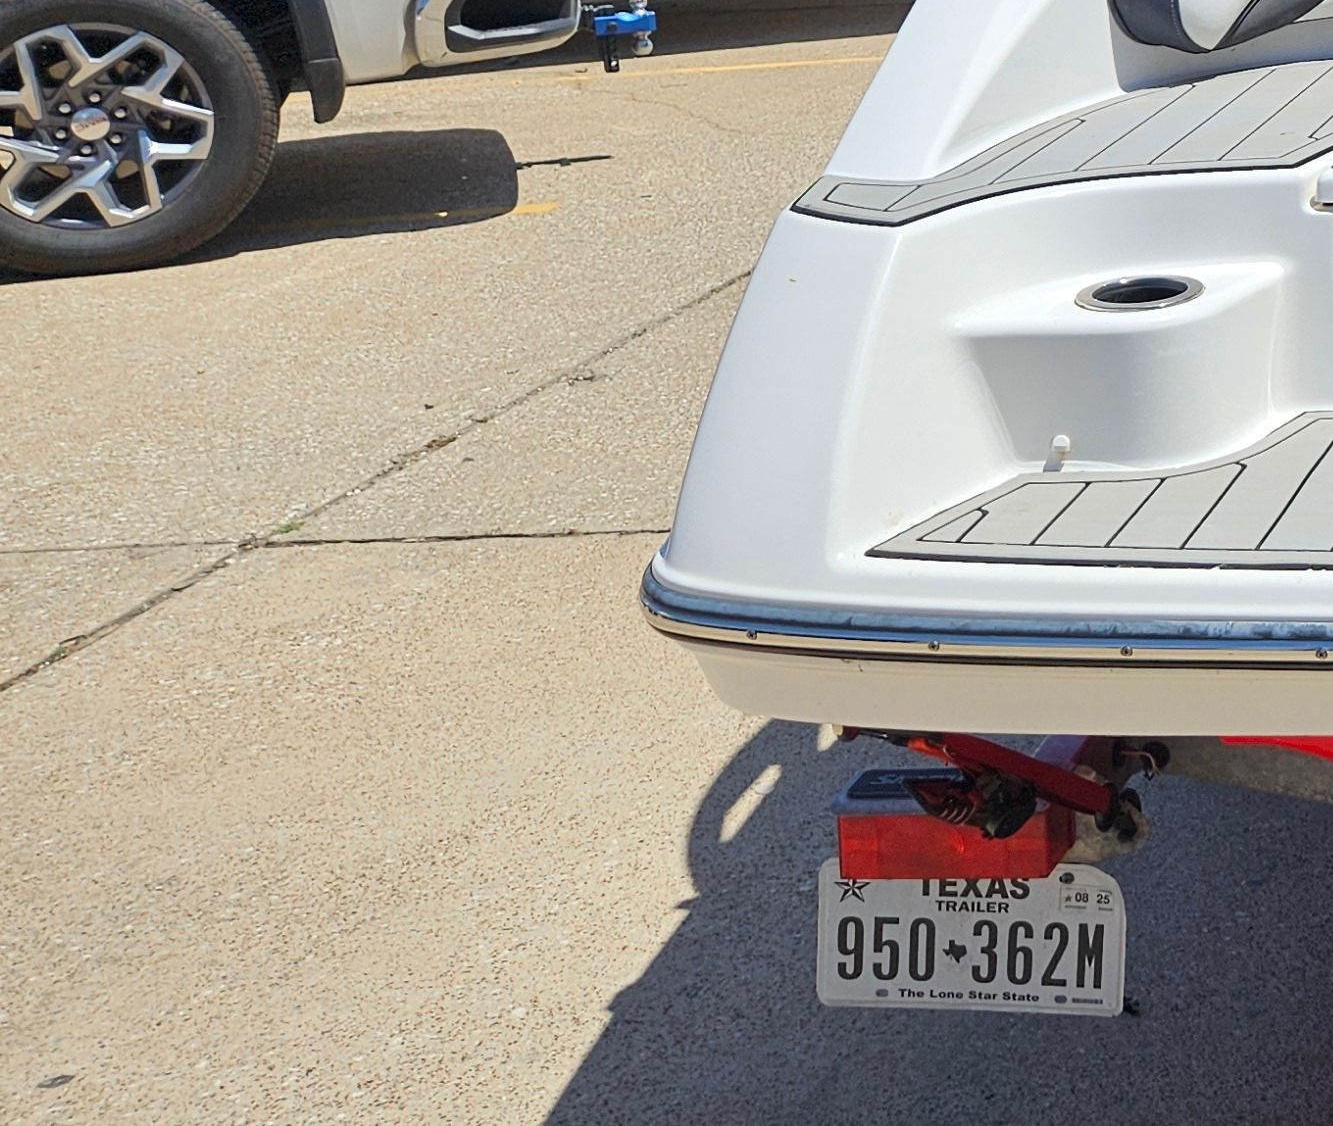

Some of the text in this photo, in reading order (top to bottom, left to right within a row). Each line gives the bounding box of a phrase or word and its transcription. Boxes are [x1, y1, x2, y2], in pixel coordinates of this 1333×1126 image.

[921, 879, 1031, 900] TEXAS
[1074, 892, 1111, 905] 08 25
[935, 900, 1010, 914] TRAILER
[837, 916, 1105, 990] 950 362M
[898, 988, 1040, 1003] The Lone Star State
